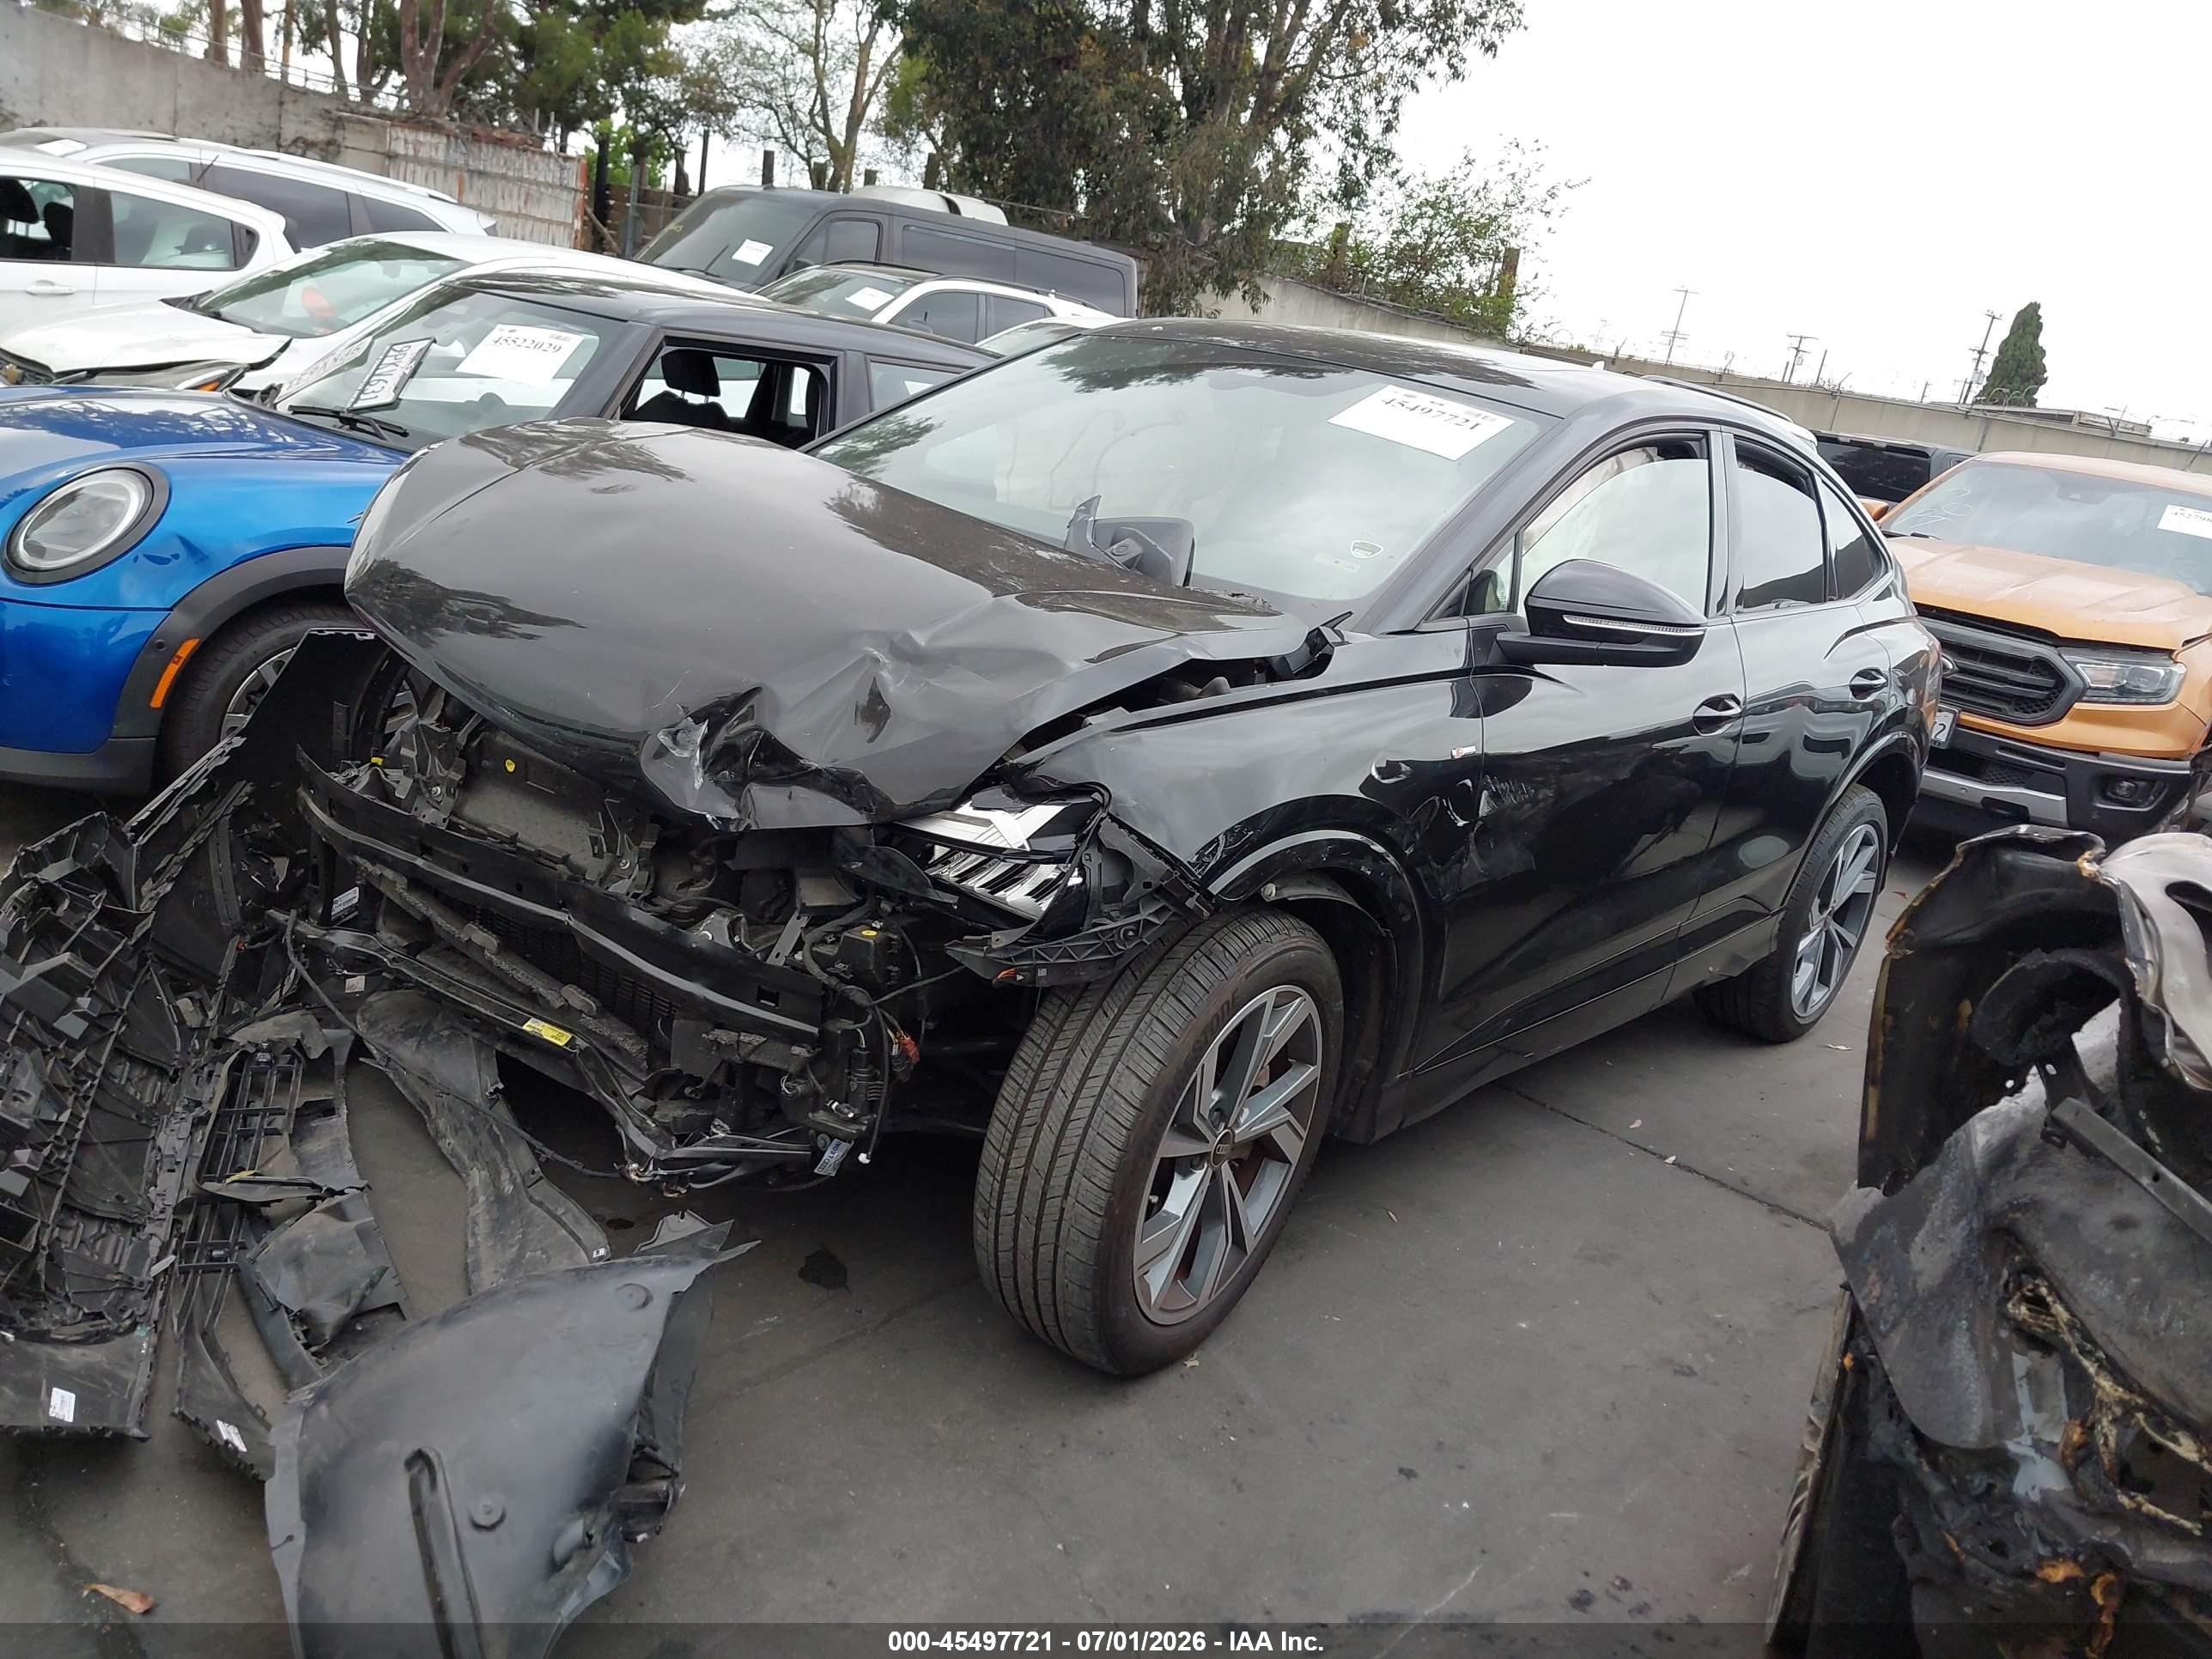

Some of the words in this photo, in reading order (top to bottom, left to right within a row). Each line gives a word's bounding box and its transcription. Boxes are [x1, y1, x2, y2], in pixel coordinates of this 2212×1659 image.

[492, 336, 562, 354] 45522029
[360, 344, 411, 401] 9PKV631
[1382, 398, 1482, 429] 45497721
